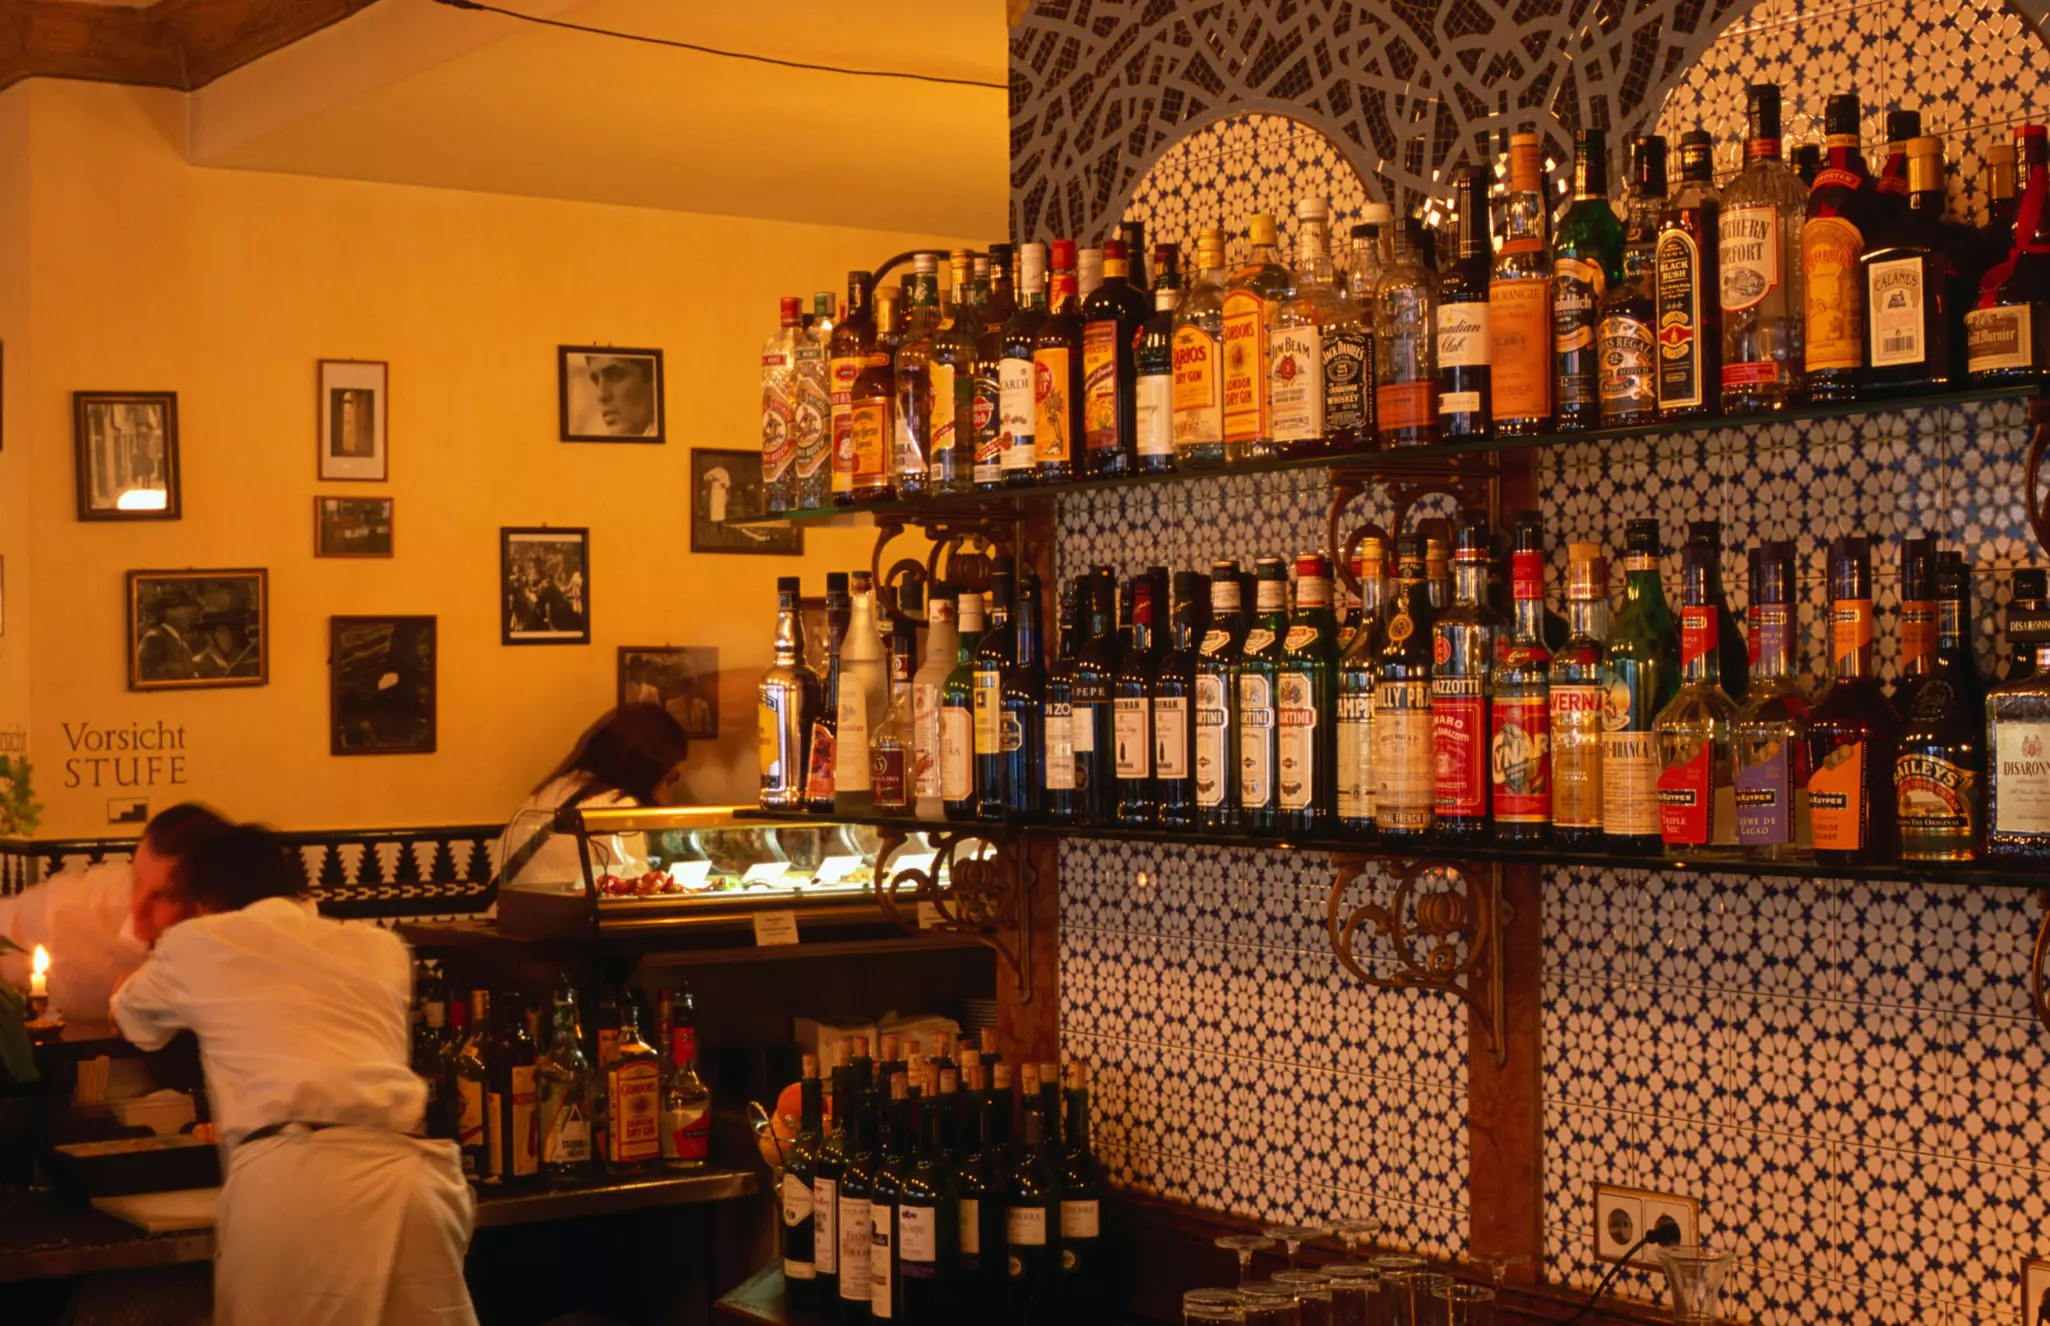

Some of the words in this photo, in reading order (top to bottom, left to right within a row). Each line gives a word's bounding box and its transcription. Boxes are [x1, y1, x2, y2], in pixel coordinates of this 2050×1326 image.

[1660, 260, 1689, 272] BLACK
[1662, 270, 1687, 281] BUSH
[1285, 336, 1310, 359] BEAM
[1616, 337, 1652, 356] REGAL
[1188, 370, 1202, 383] GIN
[1225, 377, 1252, 389] LONDON
[1225, 391, 1239, 407] DRY
[1239, 390, 1252, 404] GIN
[1406, 687, 1434, 708] PRA
[61, 719, 187, 752] Vorsicht
[63, 756, 187, 789] STUFE
